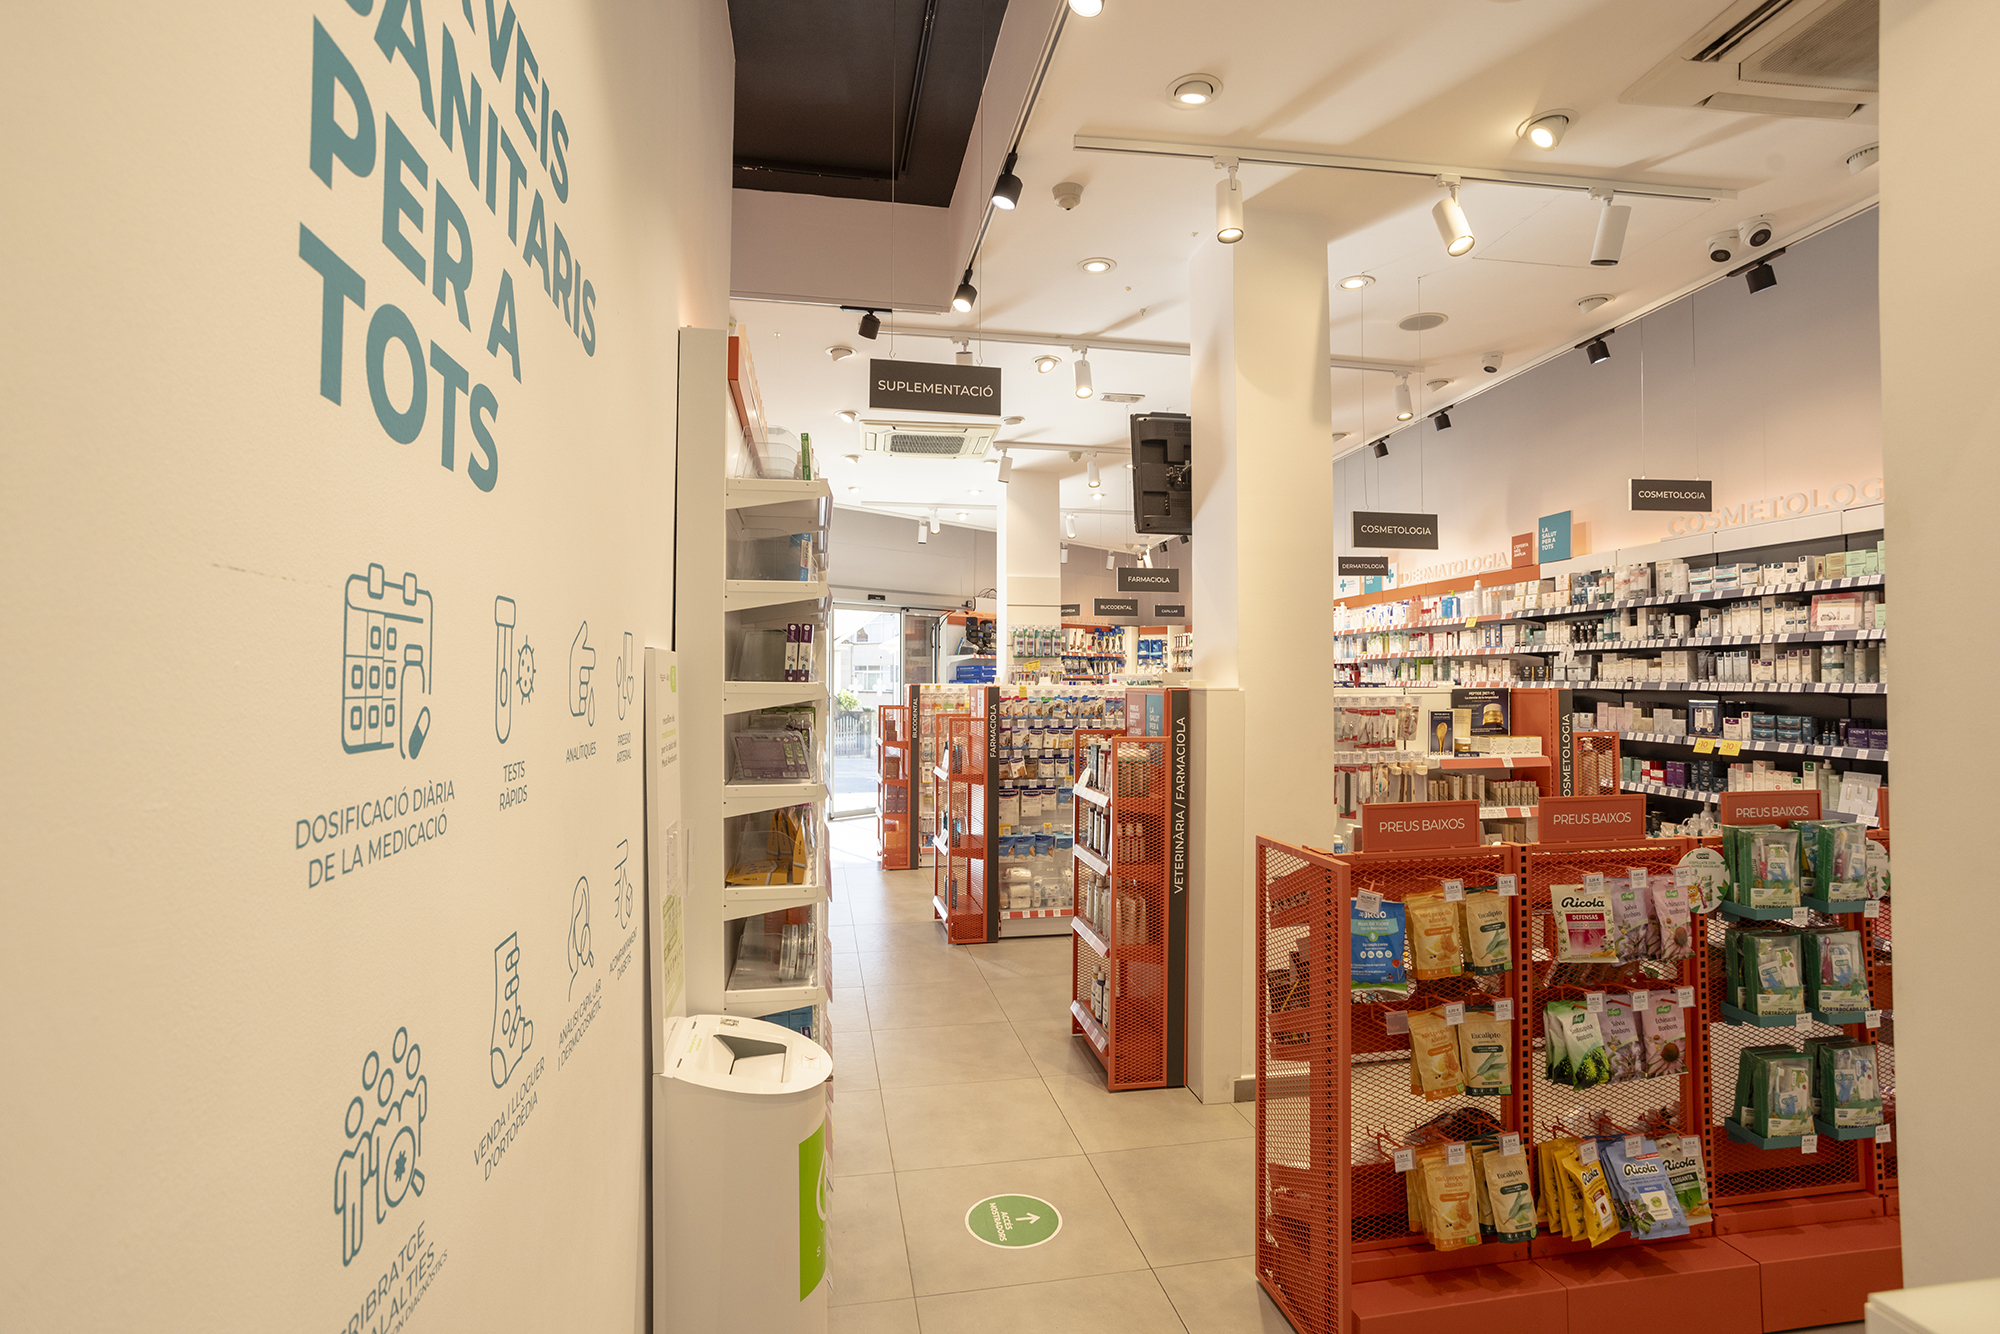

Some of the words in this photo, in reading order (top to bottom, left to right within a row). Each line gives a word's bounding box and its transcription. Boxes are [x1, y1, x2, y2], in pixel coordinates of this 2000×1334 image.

[344, 0, 596, 358] ANITARIS
[310, 14, 473, 333] PER
[486, 268, 522, 384] A
[299, 221, 499, 492] TOTS
[878, 380, 994, 398] SUPLEMENTACIÓ
[1638, 490, 1706, 500] COSMETOLOGIA
[1360, 524, 1432, 535] COSMETOLOGIA
[1542, 531, 1557, 539] SALUT
[1400, 552, 1510, 585] DERMATOLOGIA
[566, 742, 596, 763] ANALÍTIQUES
[1176, 717, 1185, 800] FARMACIOLA
[503, 761, 525, 783] TESTS
[499, 785, 528, 812] RÀPIDS
[296, 786, 409, 850] DOSIFICACIÓ
[413, 780, 455, 812] DIÀRIA
[1553, 813, 1590, 825] PREUS
[1592, 811, 1631, 824] BAIXOS
[1736, 807, 1770, 818] PREUS
[1772, 805, 1809, 816] BAIXOS
[1379, 819, 1420, 834] PREUS
[1422, 818, 1465, 831] BAIXOS
[309, 853, 335, 889] DE
[342, 844, 363, 874] LA
[368, 808, 447, 864] MEDICACIÓ
[1174, 814, 1185, 894] VETERINÀRIA
[1561, 897, 1605, 908] Ricola
[1478, 911, 1502, 919] Eucalipto
[474, 1112, 506, 1165] VENDA
[512, 1057, 544, 1114] LLOGUER
[485, 1091, 538, 1181] D'ORTOPÈDIA
[1497, 1170, 1523, 1179] Eucalipto
[1624, 1161, 1658, 1176] Ricola
[1663, 1157, 1696, 1171] Ricola
[1582, 1167, 1599, 1186] Ricola
[1671, 1174, 1694, 1184] GARGANTA
[989, 1202, 1007, 1241] MOSTRADORS
[341, 1220, 425, 1334] RIBRATGE
